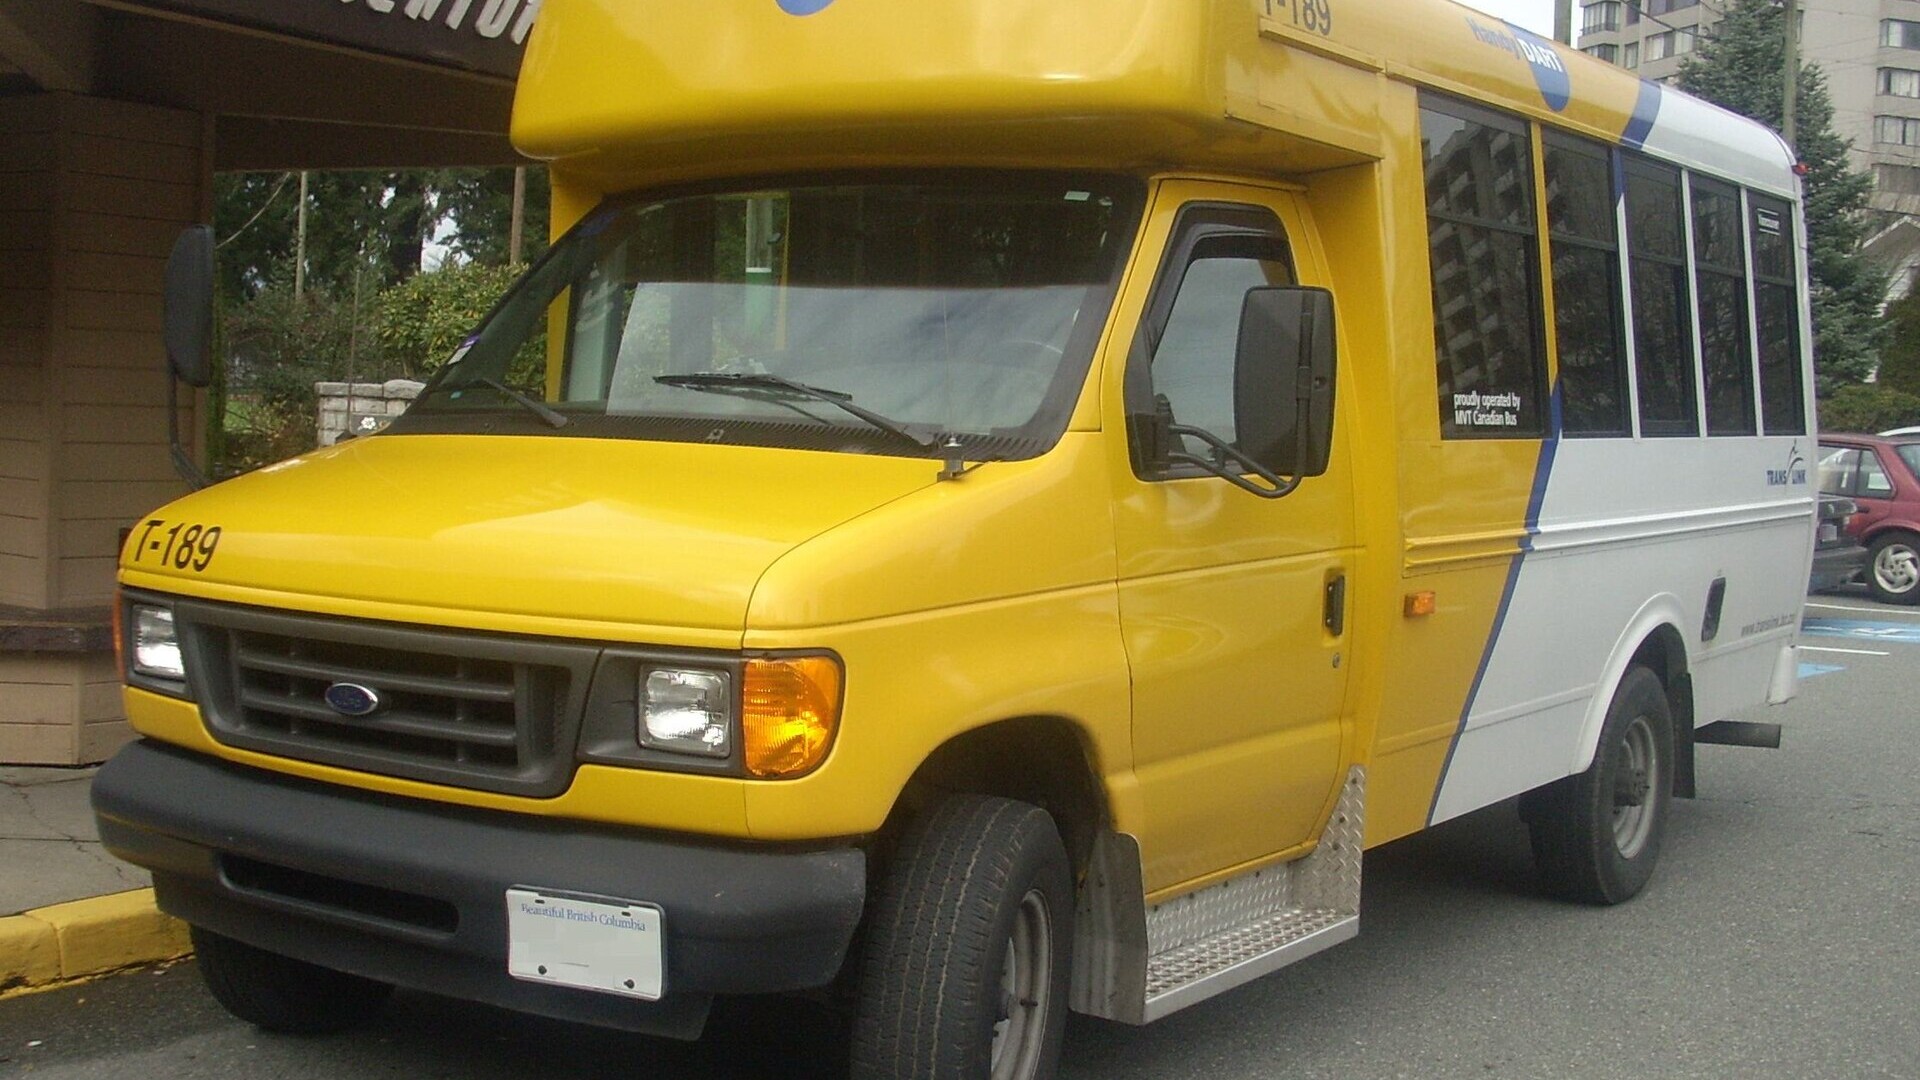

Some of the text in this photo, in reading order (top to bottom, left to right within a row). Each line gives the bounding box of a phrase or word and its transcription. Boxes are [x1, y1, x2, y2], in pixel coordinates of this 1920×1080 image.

[1454, 390, 1520, 411] proudly operated by
[1455, 410, 1517, 426] MVT Canadian Bus
[134, 519, 222, 572] T-189
[521, 903, 646, 931] Beautiful British Columbia
